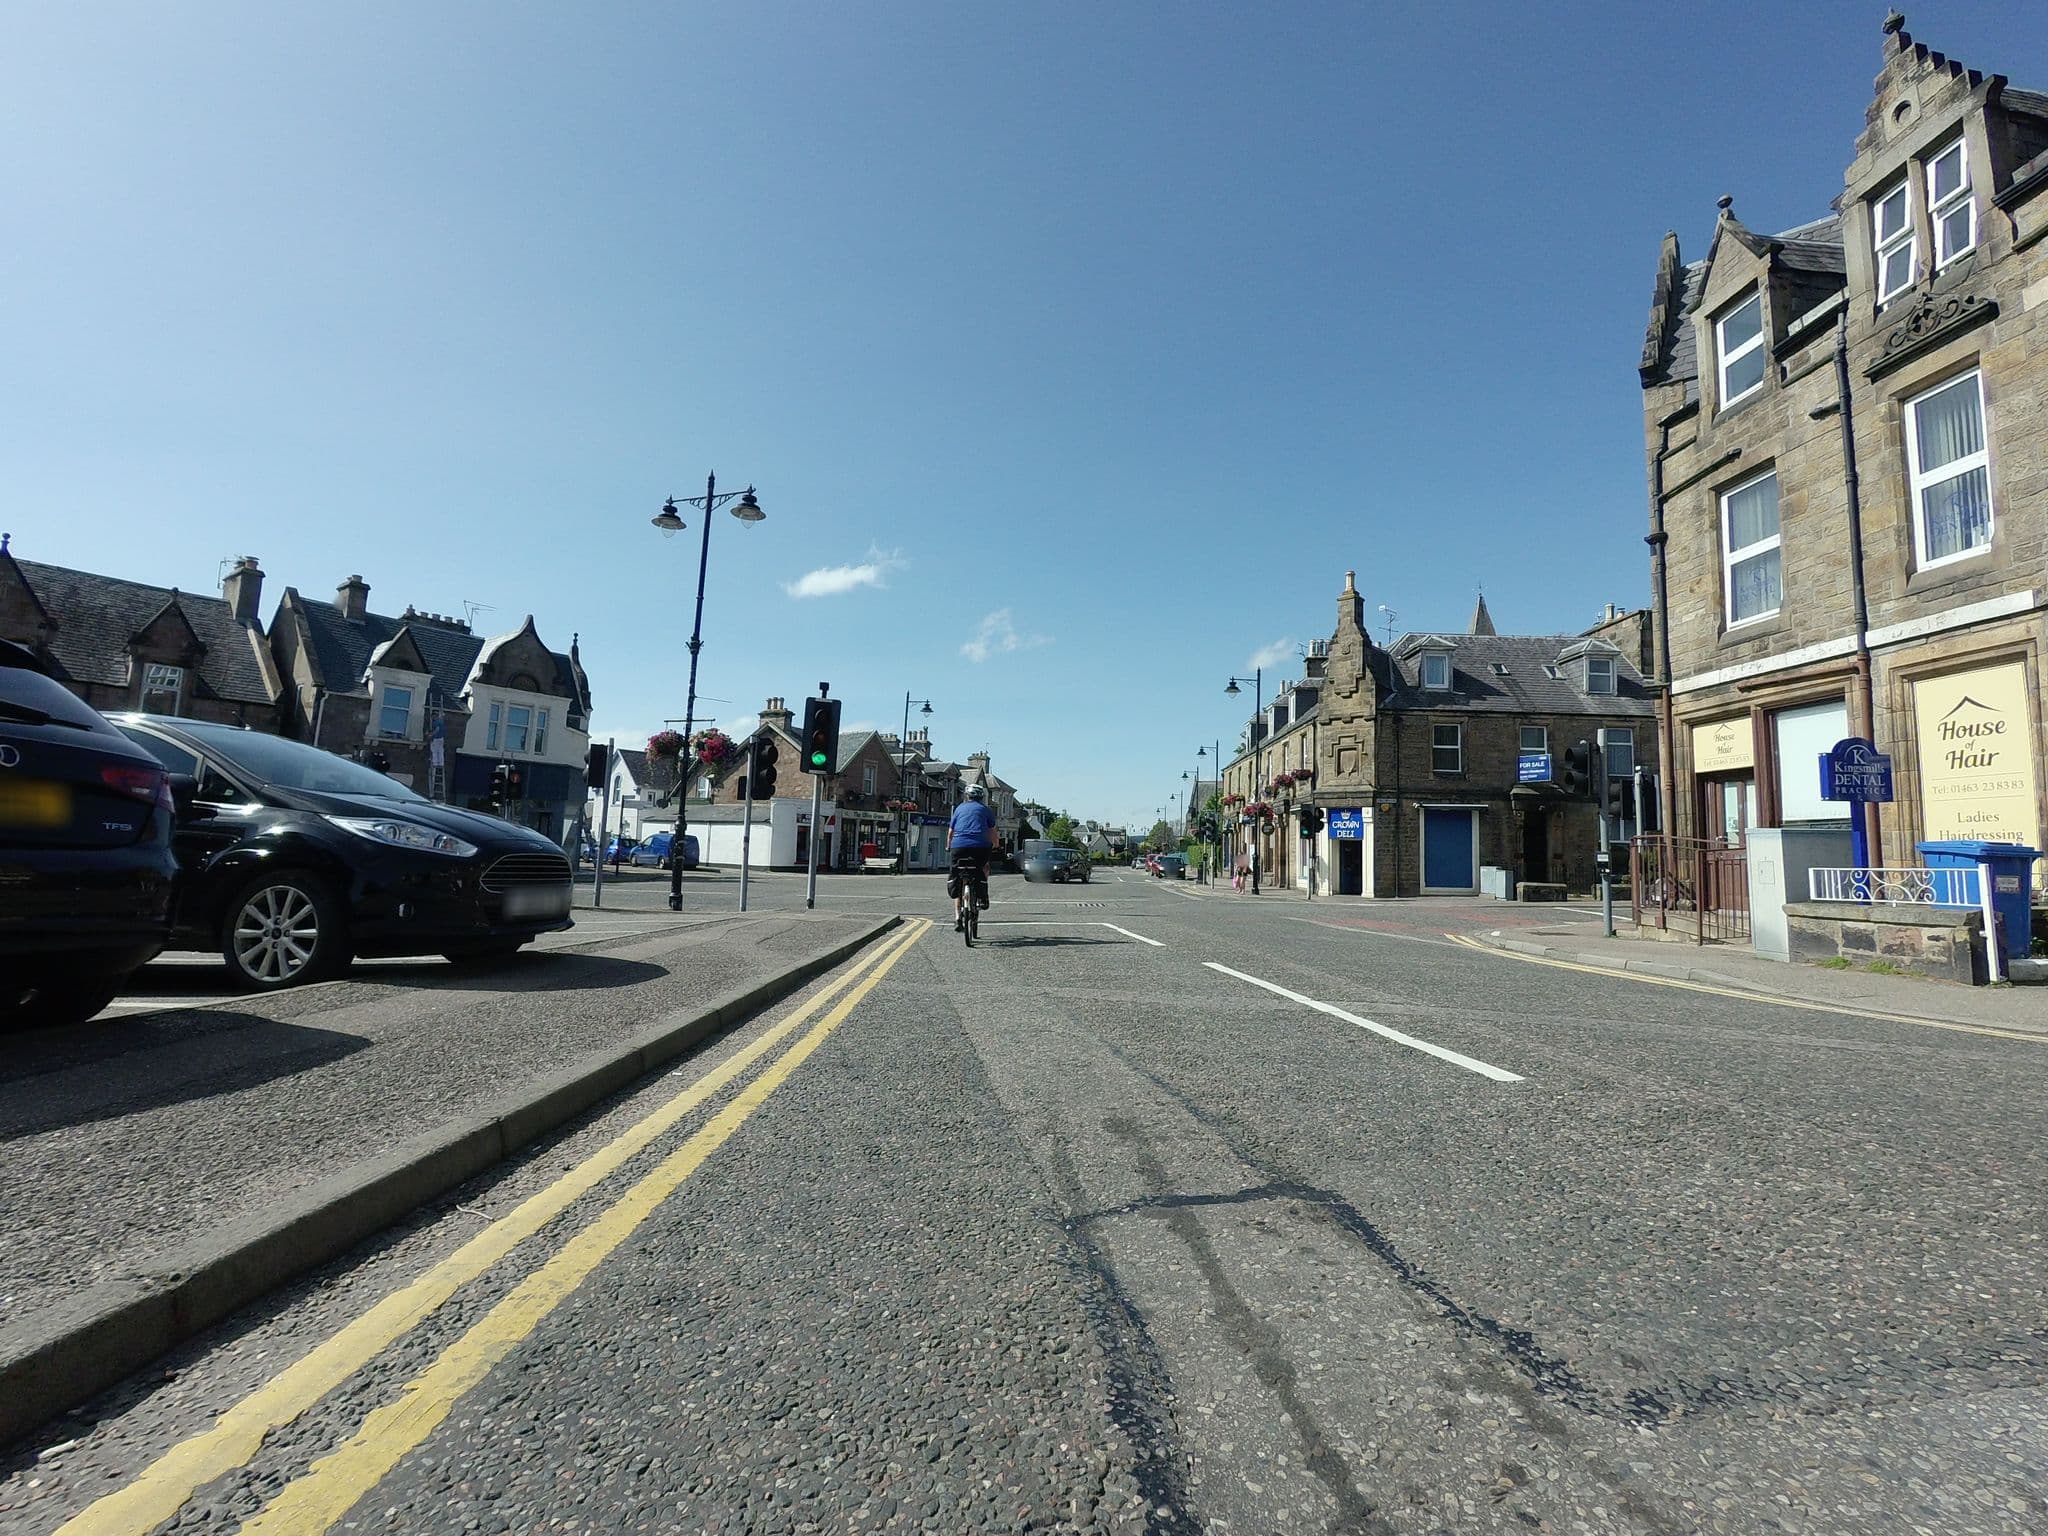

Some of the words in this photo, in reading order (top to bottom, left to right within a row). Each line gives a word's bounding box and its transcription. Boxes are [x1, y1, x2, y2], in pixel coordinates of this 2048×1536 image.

[1937, 720, 2007, 741] House
[1965, 739, 1975, 751] of
[1852, 749, 1867, 765] K
[1945, 748, 2000, 769] Hair
[1834, 761, 1885, 775] Kingsmills
[1835, 774, 1886, 786] DENTAL
[1835, 786, 1887, 795] PRACTICE
[1950, 783, 1979, 793] 01463
[1957, 810, 2000, 823] Ladies
[101, 822, 132, 831] TFSI
[1332, 820, 1360, 829] CROWN
[1336, 830, 1355, 838] DELI
[1939, 828, 2024, 842] Hairdressing
